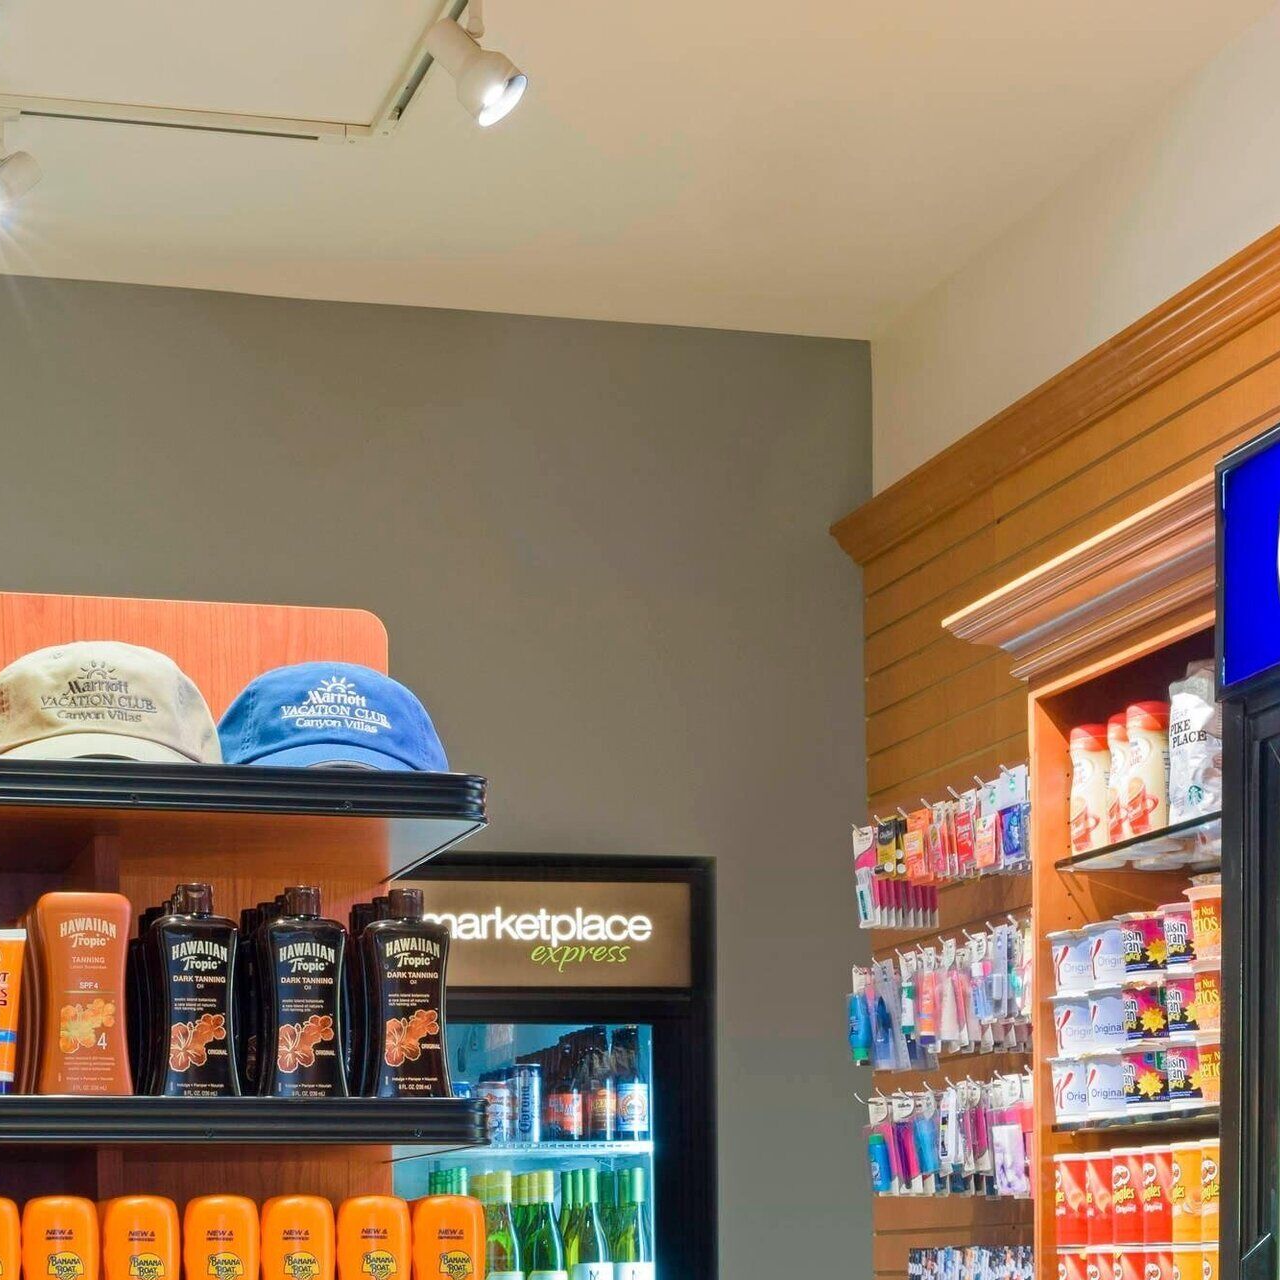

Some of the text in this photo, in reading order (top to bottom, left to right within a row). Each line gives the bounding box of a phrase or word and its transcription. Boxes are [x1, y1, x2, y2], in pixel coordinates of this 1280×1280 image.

[62, 680, 128, 696] Marriott
[41, 693, 113, 707] VACATION
[302, 690, 367, 707] Marriott
[58, 710, 142, 722] Canyon Villas
[281, 704, 350, 716] VACATION
[296, 718, 378, 733] Canyon Villas
[1170, 718, 1190, 736] PIKE
[1172, 729, 1207, 748] PLACE
[59, 916, 116, 939] HAWAIIAN
[421, 906, 652, 947] marketplace
[71, 932, 108, 948] Tropic
[172, 941, 228, 964] HAWAIIAN
[279, 941, 335, 964] HAWAIIAN
[385, 938, 440, 958] HAWAIIAN
[72, 956, 105, 964] TANNING
[183, 956, 218, 971] Tropic
[291, 957, 325, 972] Tropic
[397, 952, 431, 968] Tropic
[531, 944, 630, 973] express
[195, 976, 226, 984] TANNING
[302, 977, 333, 985] TANNING
[97, 1032, 108, 1050] 4
[1091, 1085, 1125, 1099] Original
[49, 1256, 81, 1267] BANANA
[131, 1257, 162, 1268] BANANA
[441, 1256, 472, 1266] BANANA
[56, 1265, 76, 1275] BOAT
[137, 1266, 158, 1276] BOAT
[447, 1264, 466, 1275] BOAT
